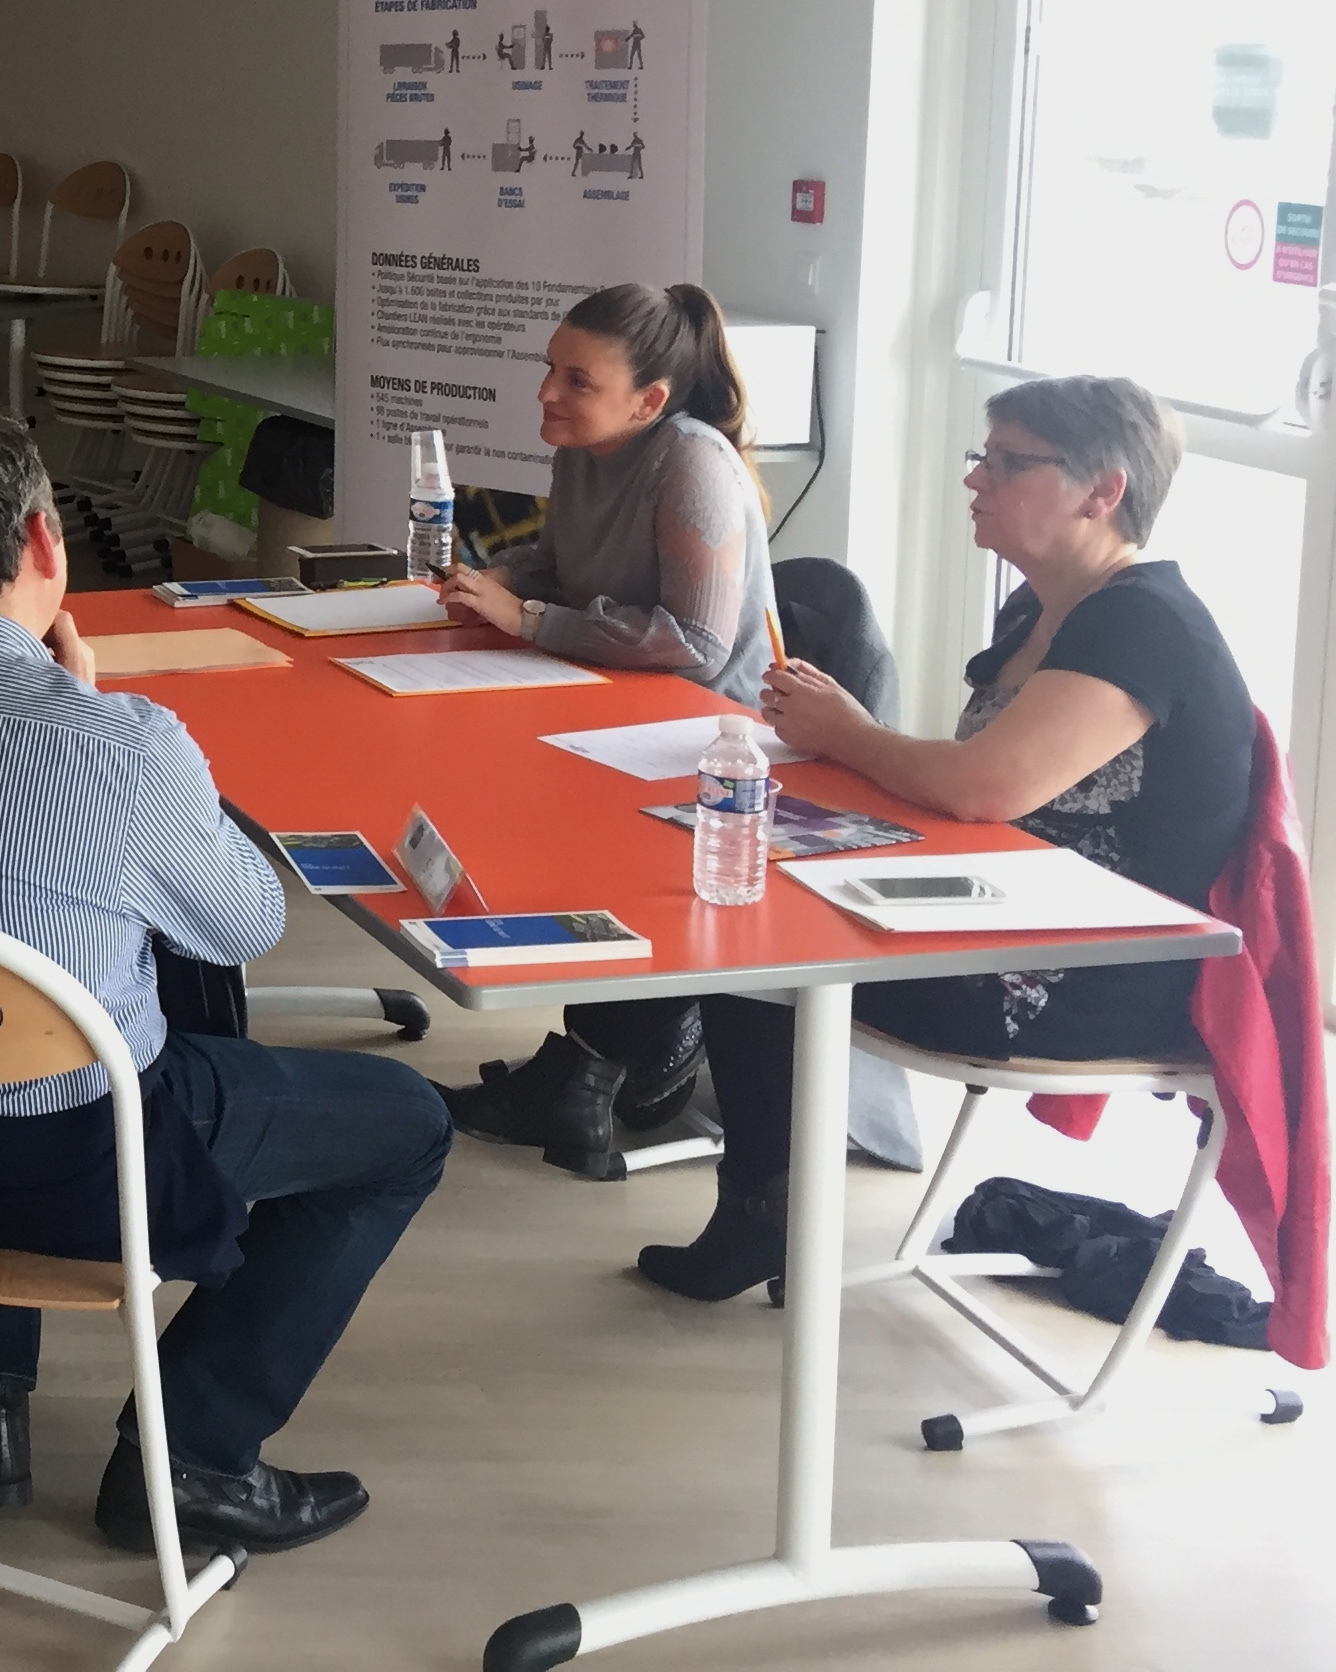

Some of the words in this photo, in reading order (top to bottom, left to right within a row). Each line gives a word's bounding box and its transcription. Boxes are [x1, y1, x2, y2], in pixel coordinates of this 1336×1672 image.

[407, 0, 418, 12] DE
[421, 0, 478, 11] FABRICATION
[372, 251, 417, 268] DONNÉES
[420, 252, 479, 272] GÉNÉRALES
[377, 269, 405, 282] Politique
[516, 281, 529, 290] des
[532, 281, 541, 291] 10
[420, 300, 428, 310] de
[498, 308, 510, 316] aux
[531, 297, 543, 307] par
[545, 298, 560, 307] jour
[409, 312, 427, 323] LEAN
[487, 321, 525, 332] opérateurs
[450, 330, 459, 340] de
[437, 344, 452, 353] pour
[371, 375, 411, 392] MOYENS
[414, 379, 427, 394] DE
[430, 382, 496, 402] PRODUCTION
[409, 410, 419, 420] de
[492, 449, 506, 458] non
